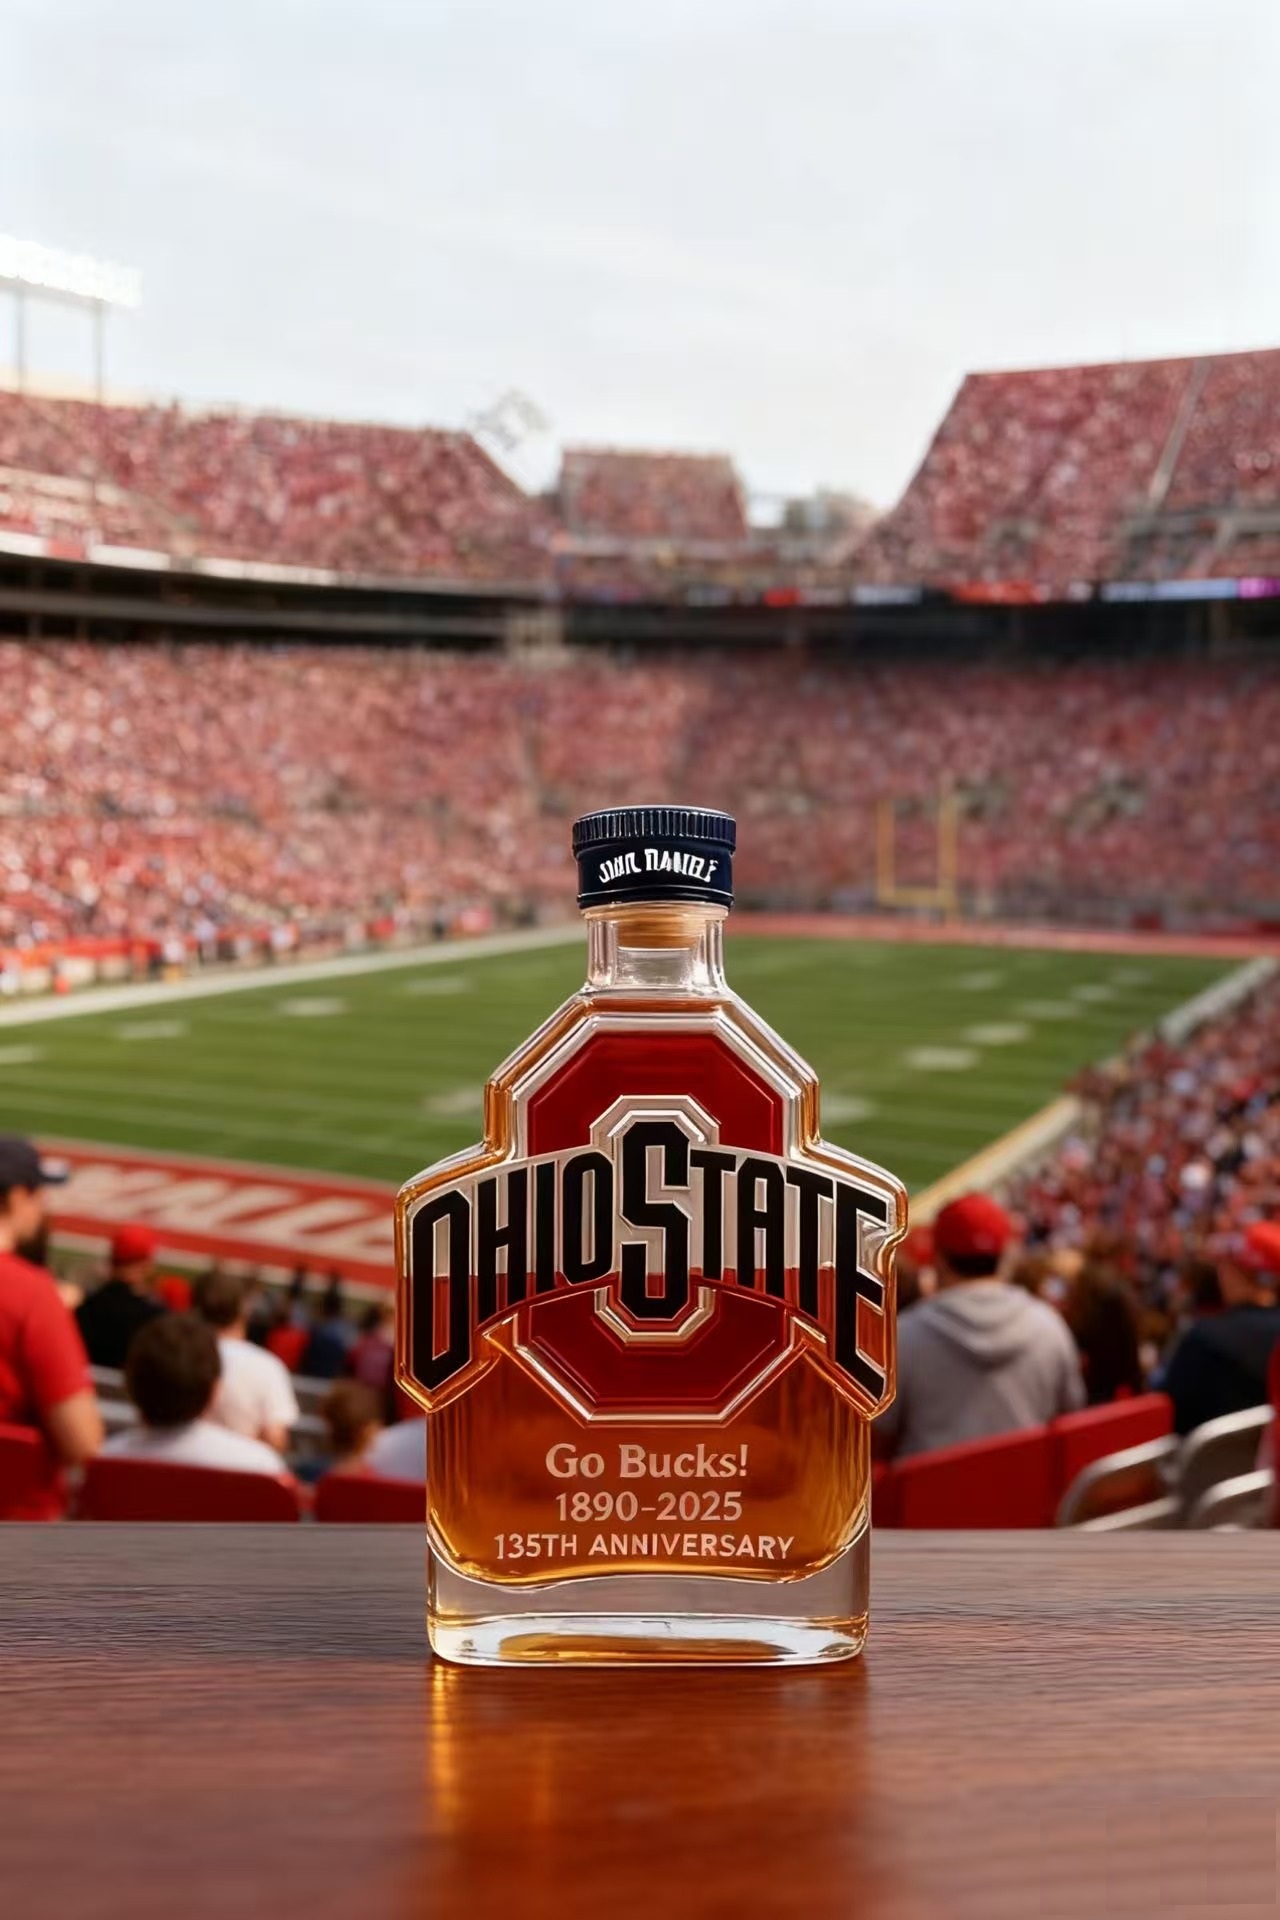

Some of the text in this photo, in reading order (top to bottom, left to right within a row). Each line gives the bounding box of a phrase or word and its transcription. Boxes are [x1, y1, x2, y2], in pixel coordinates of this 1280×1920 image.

[411, 1151, 613, 1392] OHIO
[619, 1121, 888, 1402] STATE
[545, 1443, 749, 1478] Go Bucks!
[556, 1491, 743, 1522] 1890-2025
[494, 1533, 795, 1560] 135TH ANNIVERSARY
